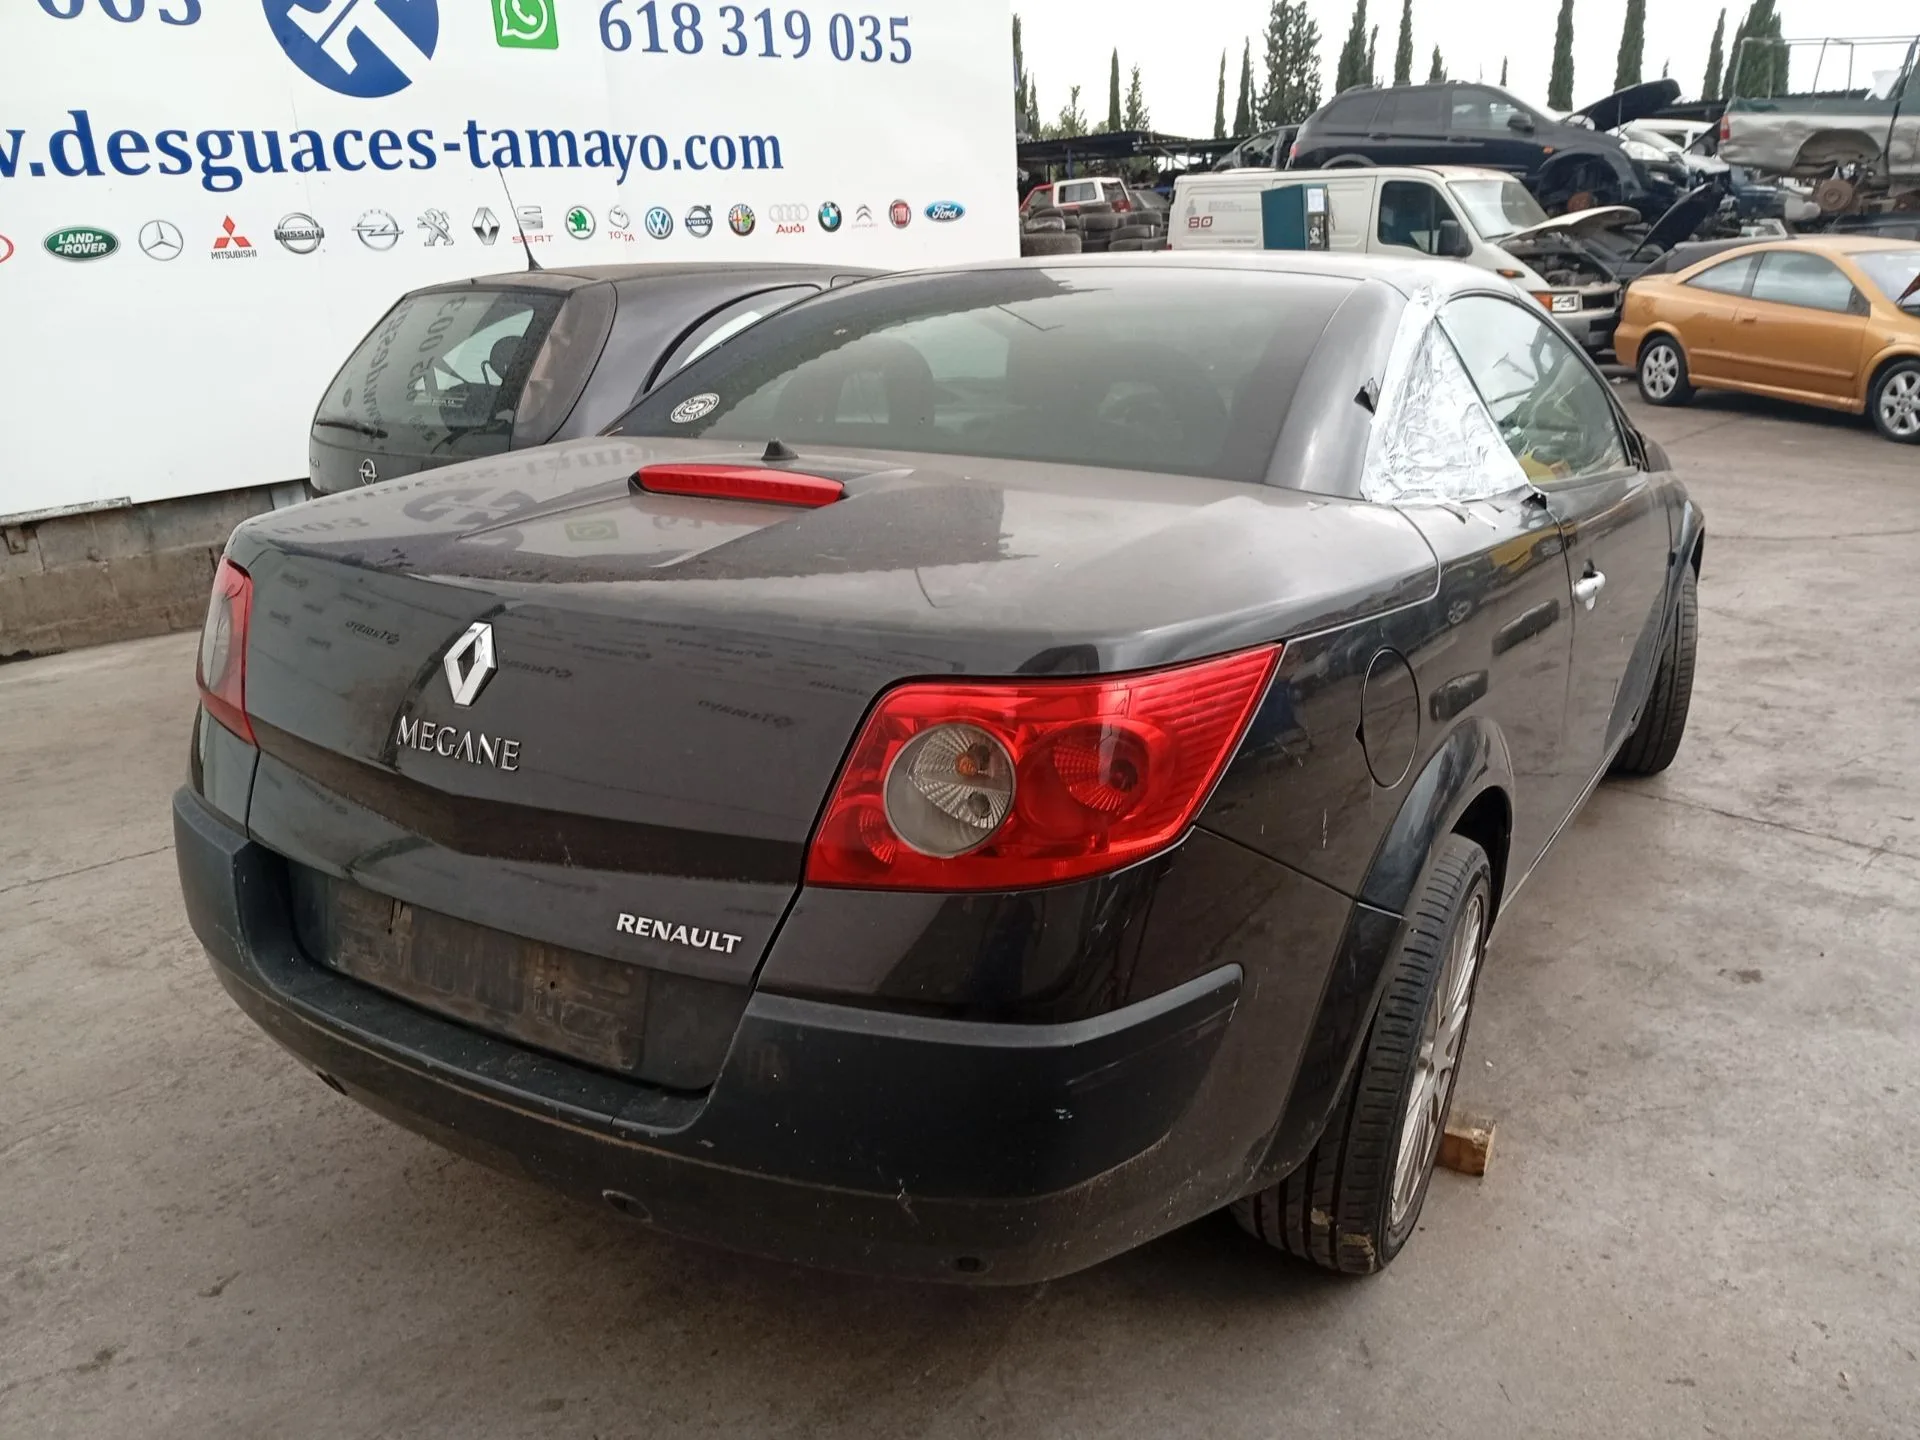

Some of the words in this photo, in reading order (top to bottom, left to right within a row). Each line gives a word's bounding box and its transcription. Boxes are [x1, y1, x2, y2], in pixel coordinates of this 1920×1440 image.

[599, 0, 704, 54] 618
[719, 5, 811, 59] 319
[829, 13, 912, 64] 035
[932, 205, 958, 219] Ford
[58, 232, 95, 245] LAND
[512, 234, 554, 244] SEAT
[63, 242, 107, 254] ROVER
[211, 249, 258, 261] MITSUBISHI
[396, 715, 520, 771] MEGANE
[616, 913, 742, 953] RENAULT
